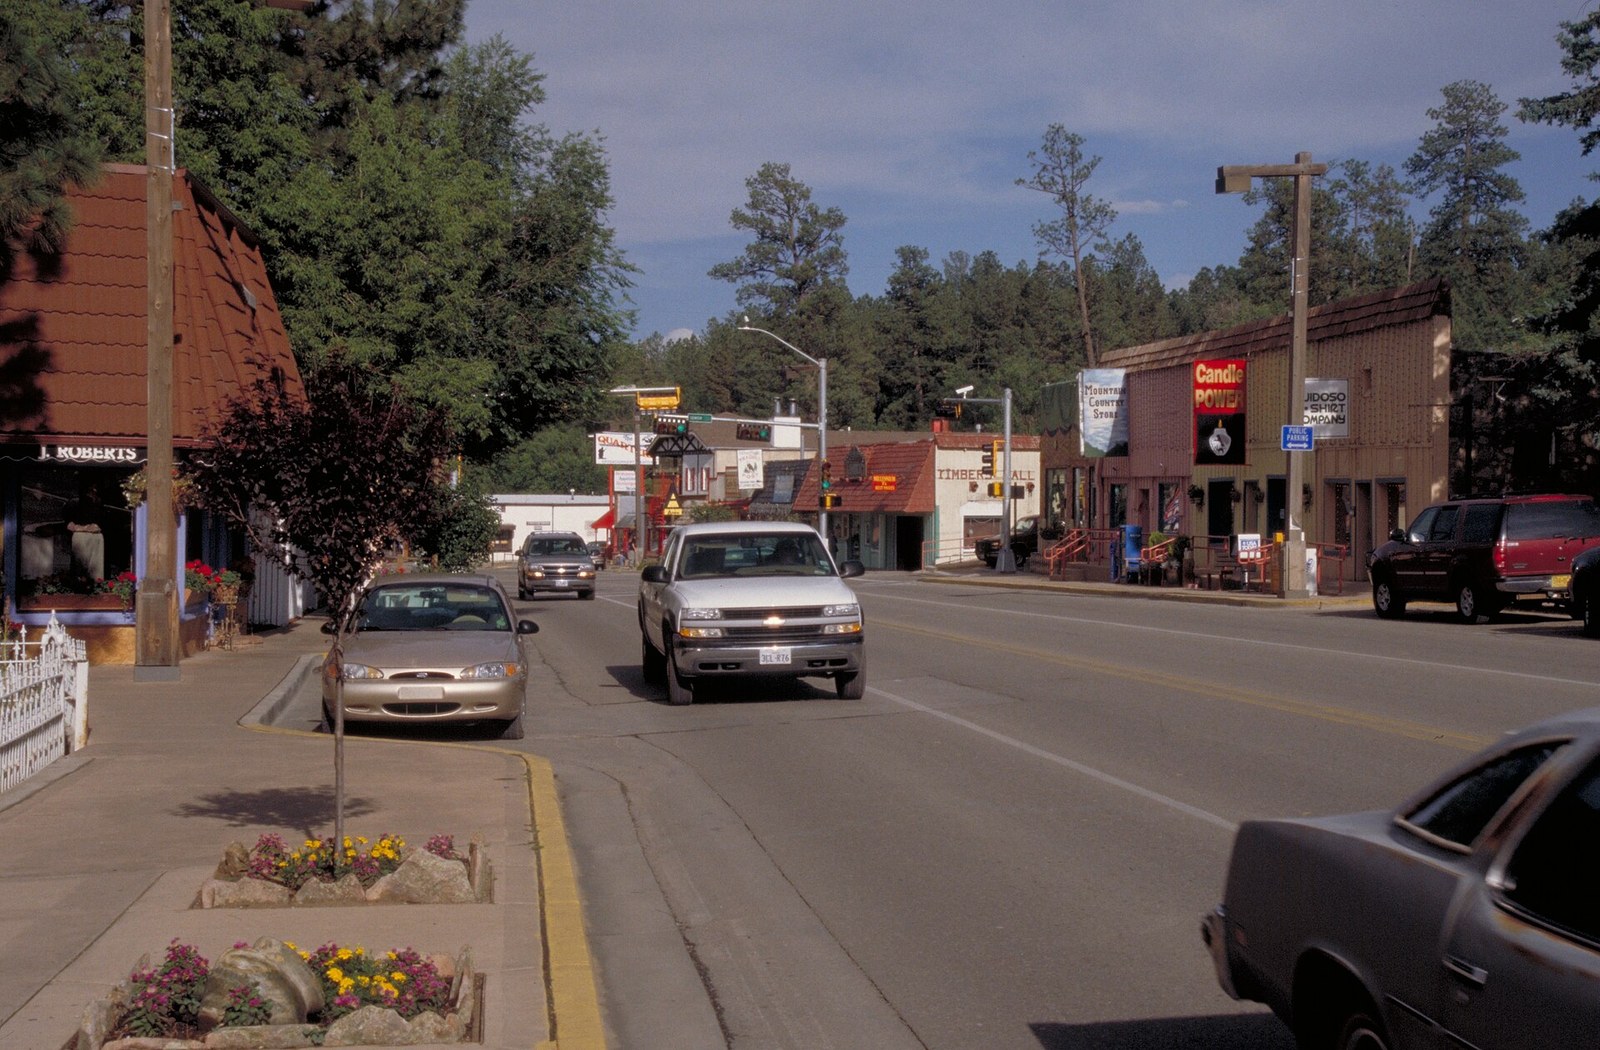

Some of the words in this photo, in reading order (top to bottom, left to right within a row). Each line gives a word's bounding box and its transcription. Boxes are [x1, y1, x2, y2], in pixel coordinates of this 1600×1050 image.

[1195, 363, 1244, 384] Candle
[1084, 384, 1126, 395] MOUNTAIN
[1089, 397, 1125, 407] COUNTRY
[1195, 388, 1244, 408] POWER
[1304, 392, 1346, 402] UIDOSO
[1093, 408, 1119, 419] STORE
[1303, 414, 1346, 425] OMPANY
[1286, 434, 1309, 442] PARKING
[38, 445, 50, 460] J.
[56, 446, 137, 461] ROBERTS
[1011, 470, 1035, 480] ALL
